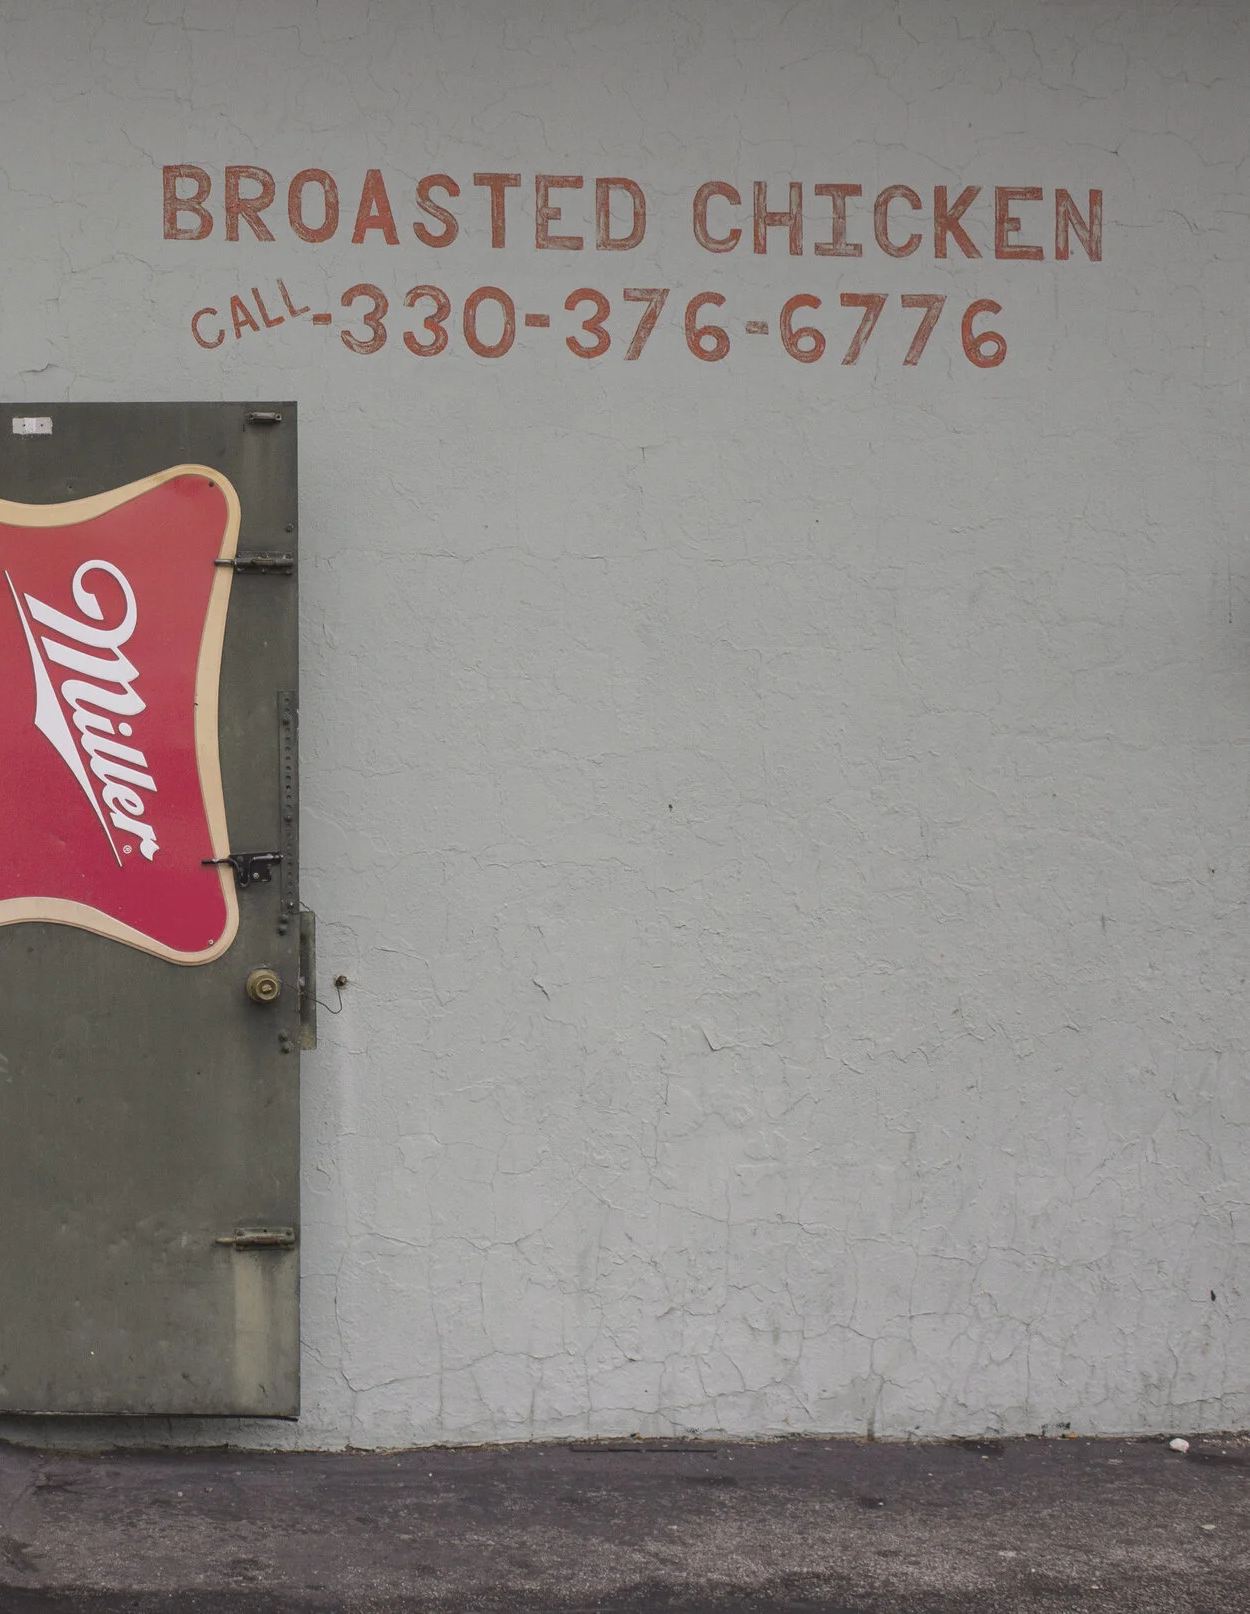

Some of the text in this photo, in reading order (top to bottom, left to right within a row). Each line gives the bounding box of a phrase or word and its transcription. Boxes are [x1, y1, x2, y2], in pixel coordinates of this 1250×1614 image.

[162, 164, 1103, 262] BROASTED CHICKEN
[191, 278, 311, 350] CALL
[23, 559, 160, 861] Miller
